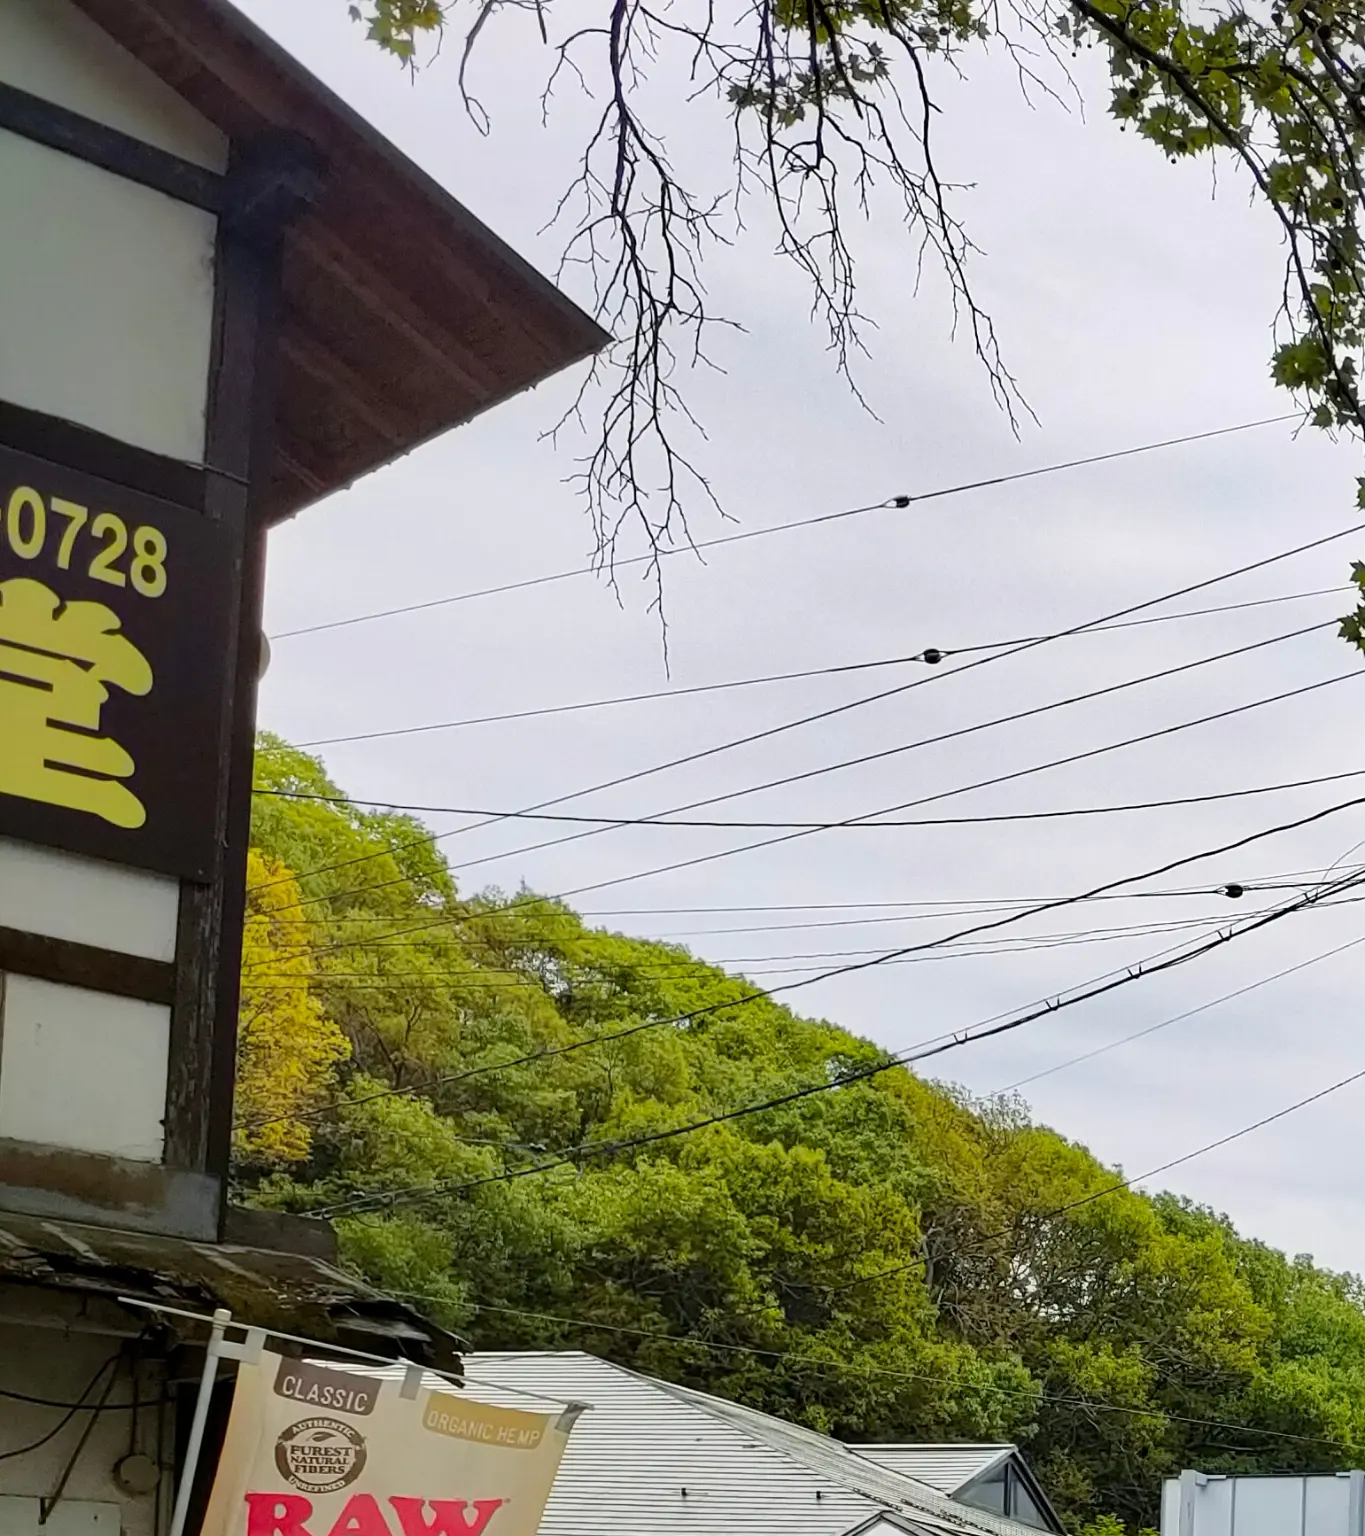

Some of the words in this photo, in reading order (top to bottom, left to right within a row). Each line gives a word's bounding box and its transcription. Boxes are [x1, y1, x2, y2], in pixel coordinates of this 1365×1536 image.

[282, 1376, 368, 1412] CLASSIC
[292, 1420, 355, 1438] AUTHENTIC
[427, 1410, 494, 1441] ORGANIC
[496, 1427, 541, 1446] HEMP
[290, 1456, 349, 1465] NATURAL
[294, 1464, 345, 1474] FIBERS
[288, 1475, 346, 1492] UNREFINED
